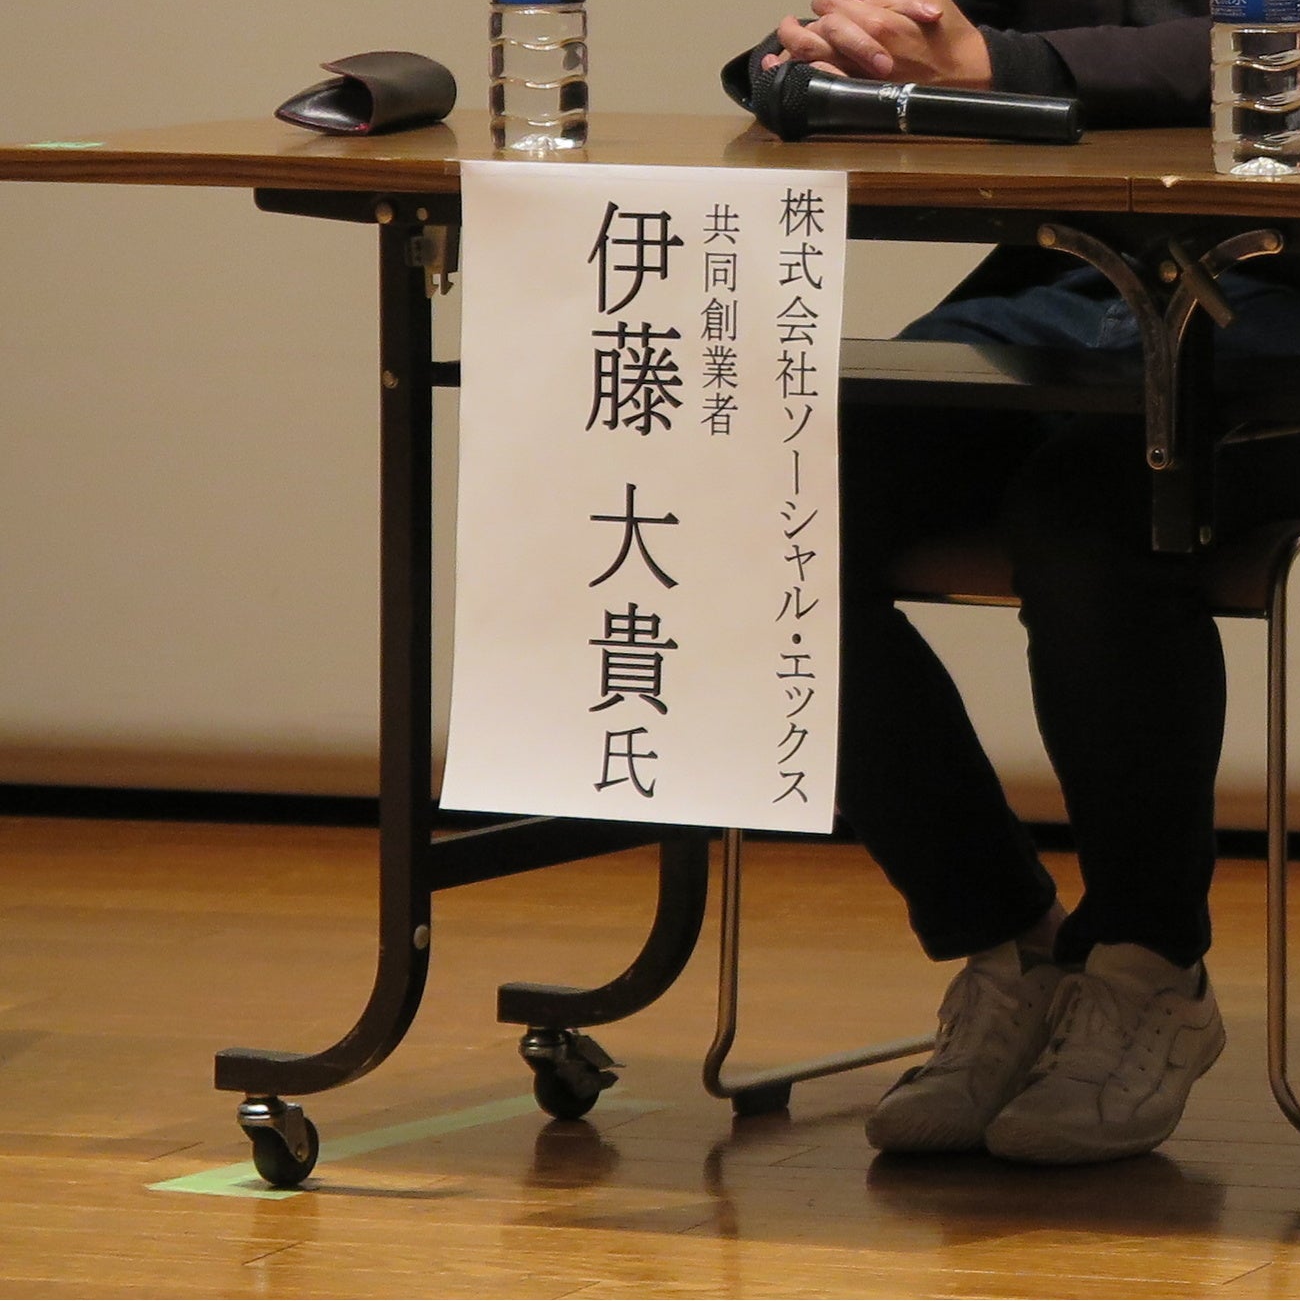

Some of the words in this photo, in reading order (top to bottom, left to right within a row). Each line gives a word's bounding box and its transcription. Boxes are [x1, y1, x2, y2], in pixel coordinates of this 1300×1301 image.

[585, 200, 685, 437] 伊藤
[700, 202, 741, 437] 共同創業者
[773, 187, 826, 804] 株式会社ソーシャル・エックス
[588, 482, 680, 799] 大貴氏
